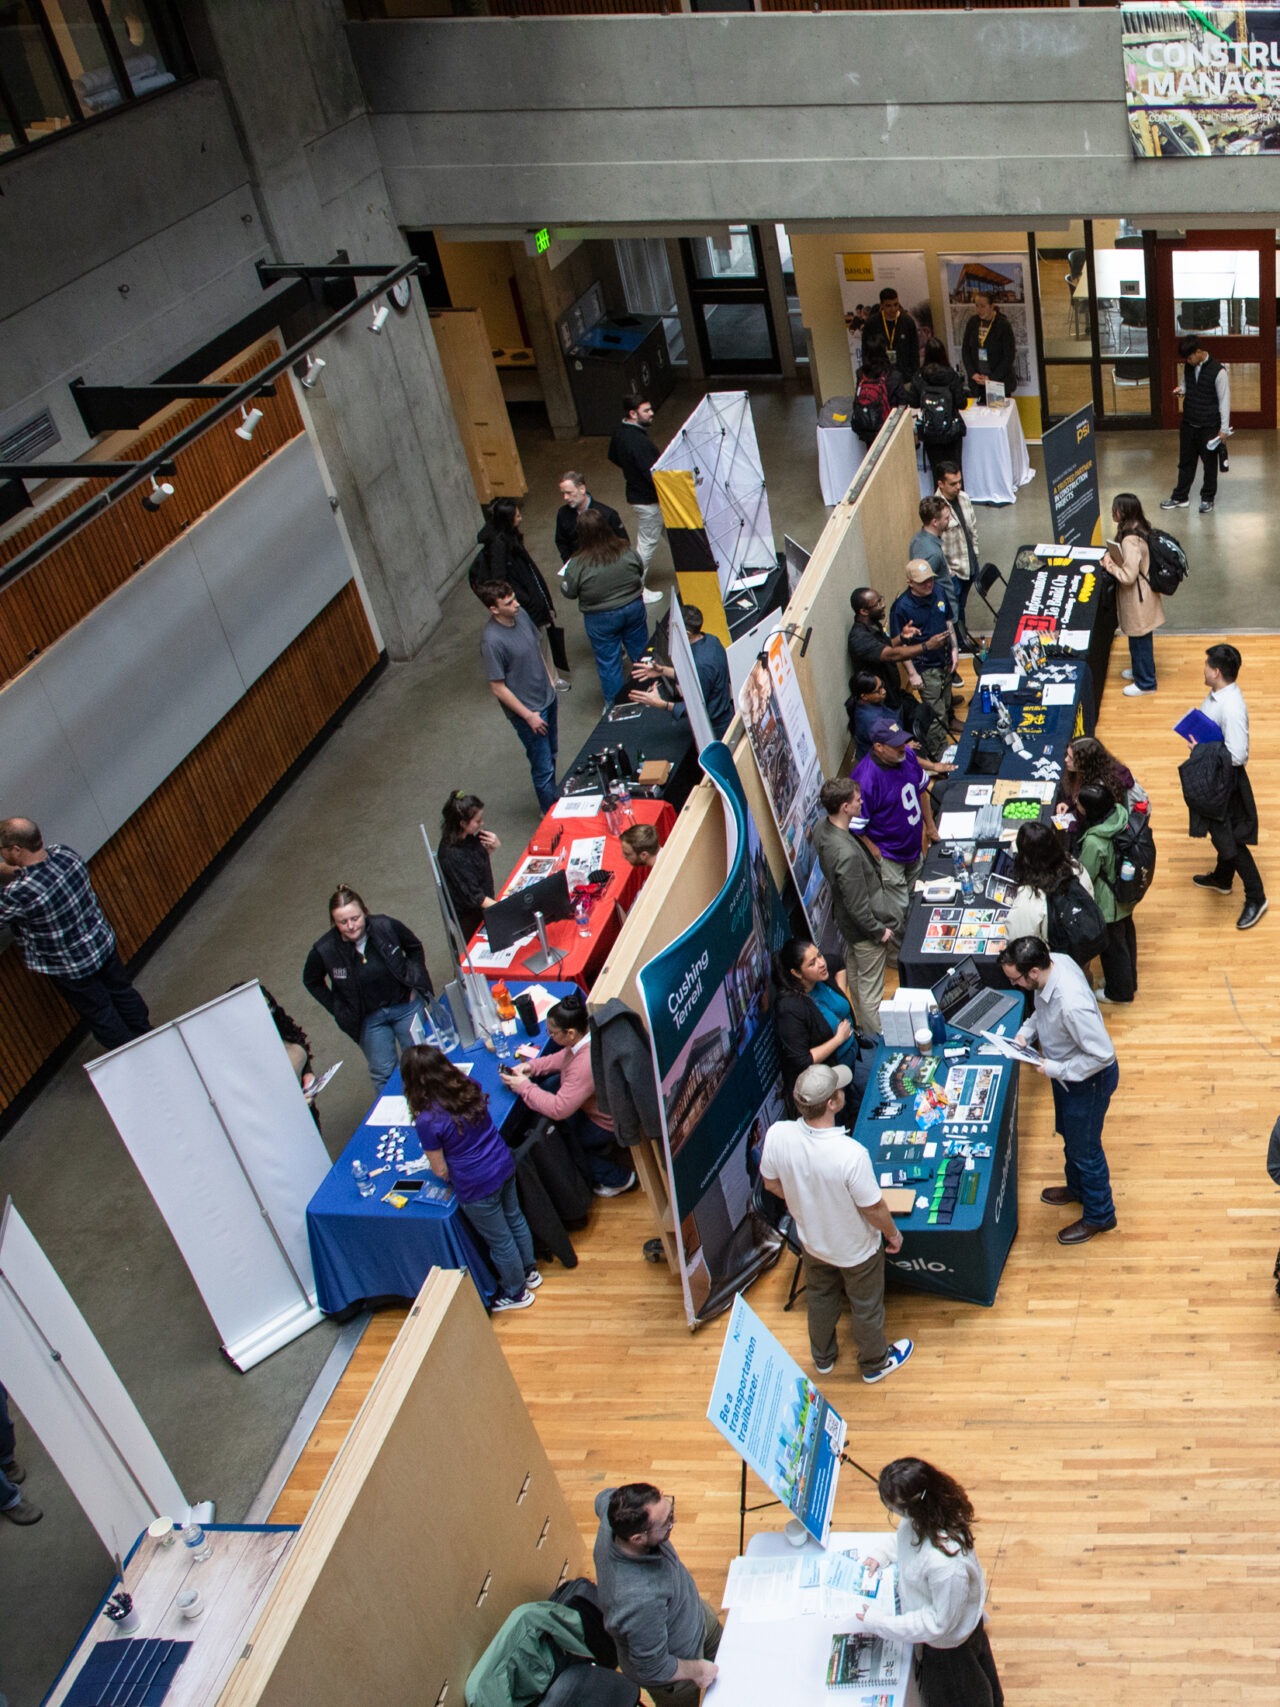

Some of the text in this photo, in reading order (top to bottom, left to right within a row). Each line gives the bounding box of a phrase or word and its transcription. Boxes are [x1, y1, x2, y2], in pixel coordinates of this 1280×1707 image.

[535, 227, 550, 254] EXIT
[1076, 423, 1091, 445] psi
[1022, 571, 1048, 615] Information
[1046, 585, 1066, 608] Build
[1051, 574, 1068, 588] On
[900, 782, 922, 827] 9
[667, 948, 710, 1015] Cushing
[672, 976, 703, 1031] Terrell
[728, 1335, 758, 1434] transportation
[719, 1391, 734, 1425] Be a
[737, 1373, 761, 1444] trailblazer.
